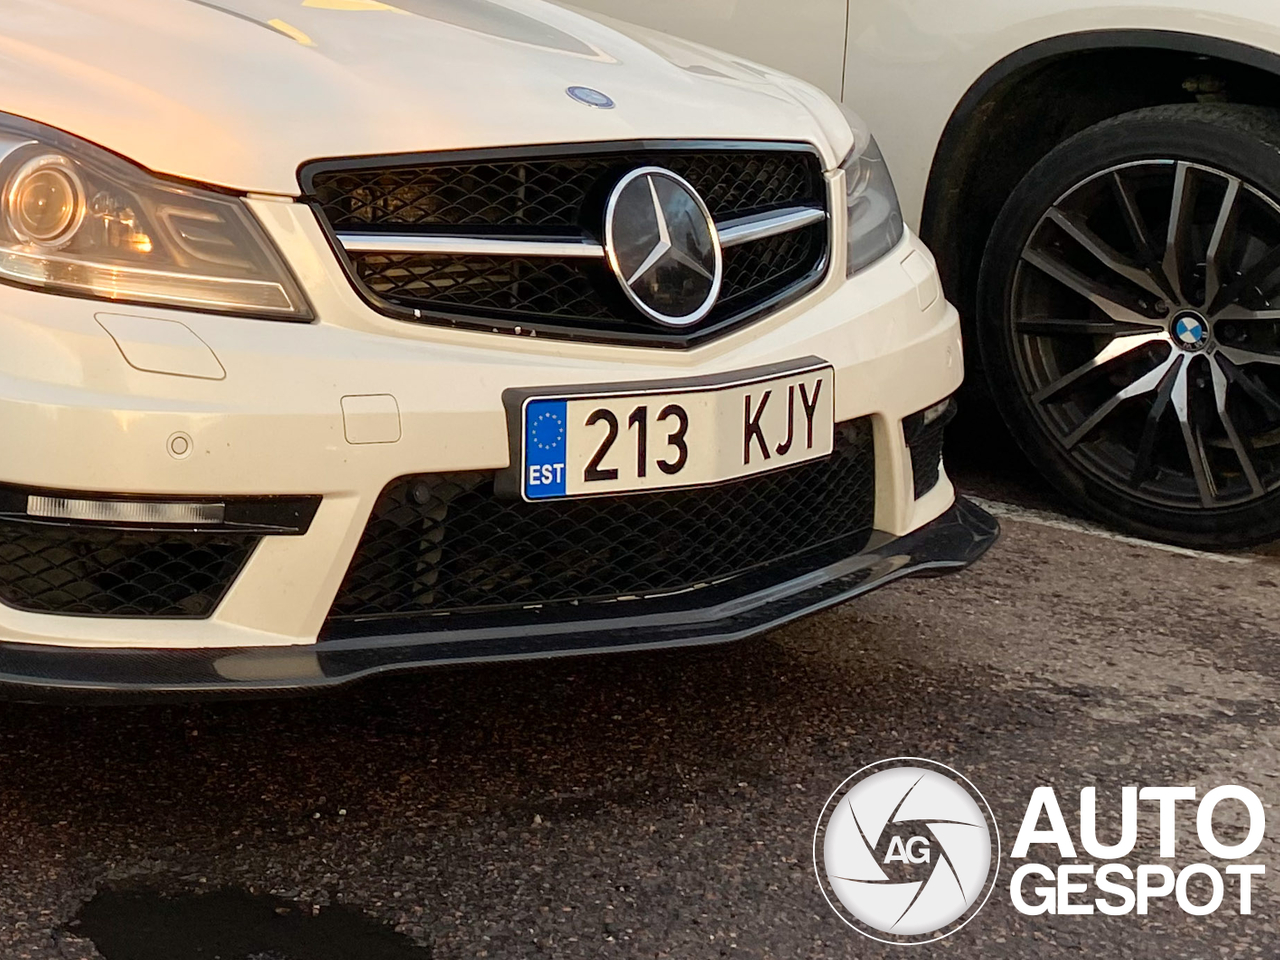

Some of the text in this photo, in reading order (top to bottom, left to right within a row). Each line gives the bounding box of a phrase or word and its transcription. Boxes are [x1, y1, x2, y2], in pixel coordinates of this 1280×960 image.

[583, 378, 823, 483] 213 KJY
[528, 463, 565, 486] EST
